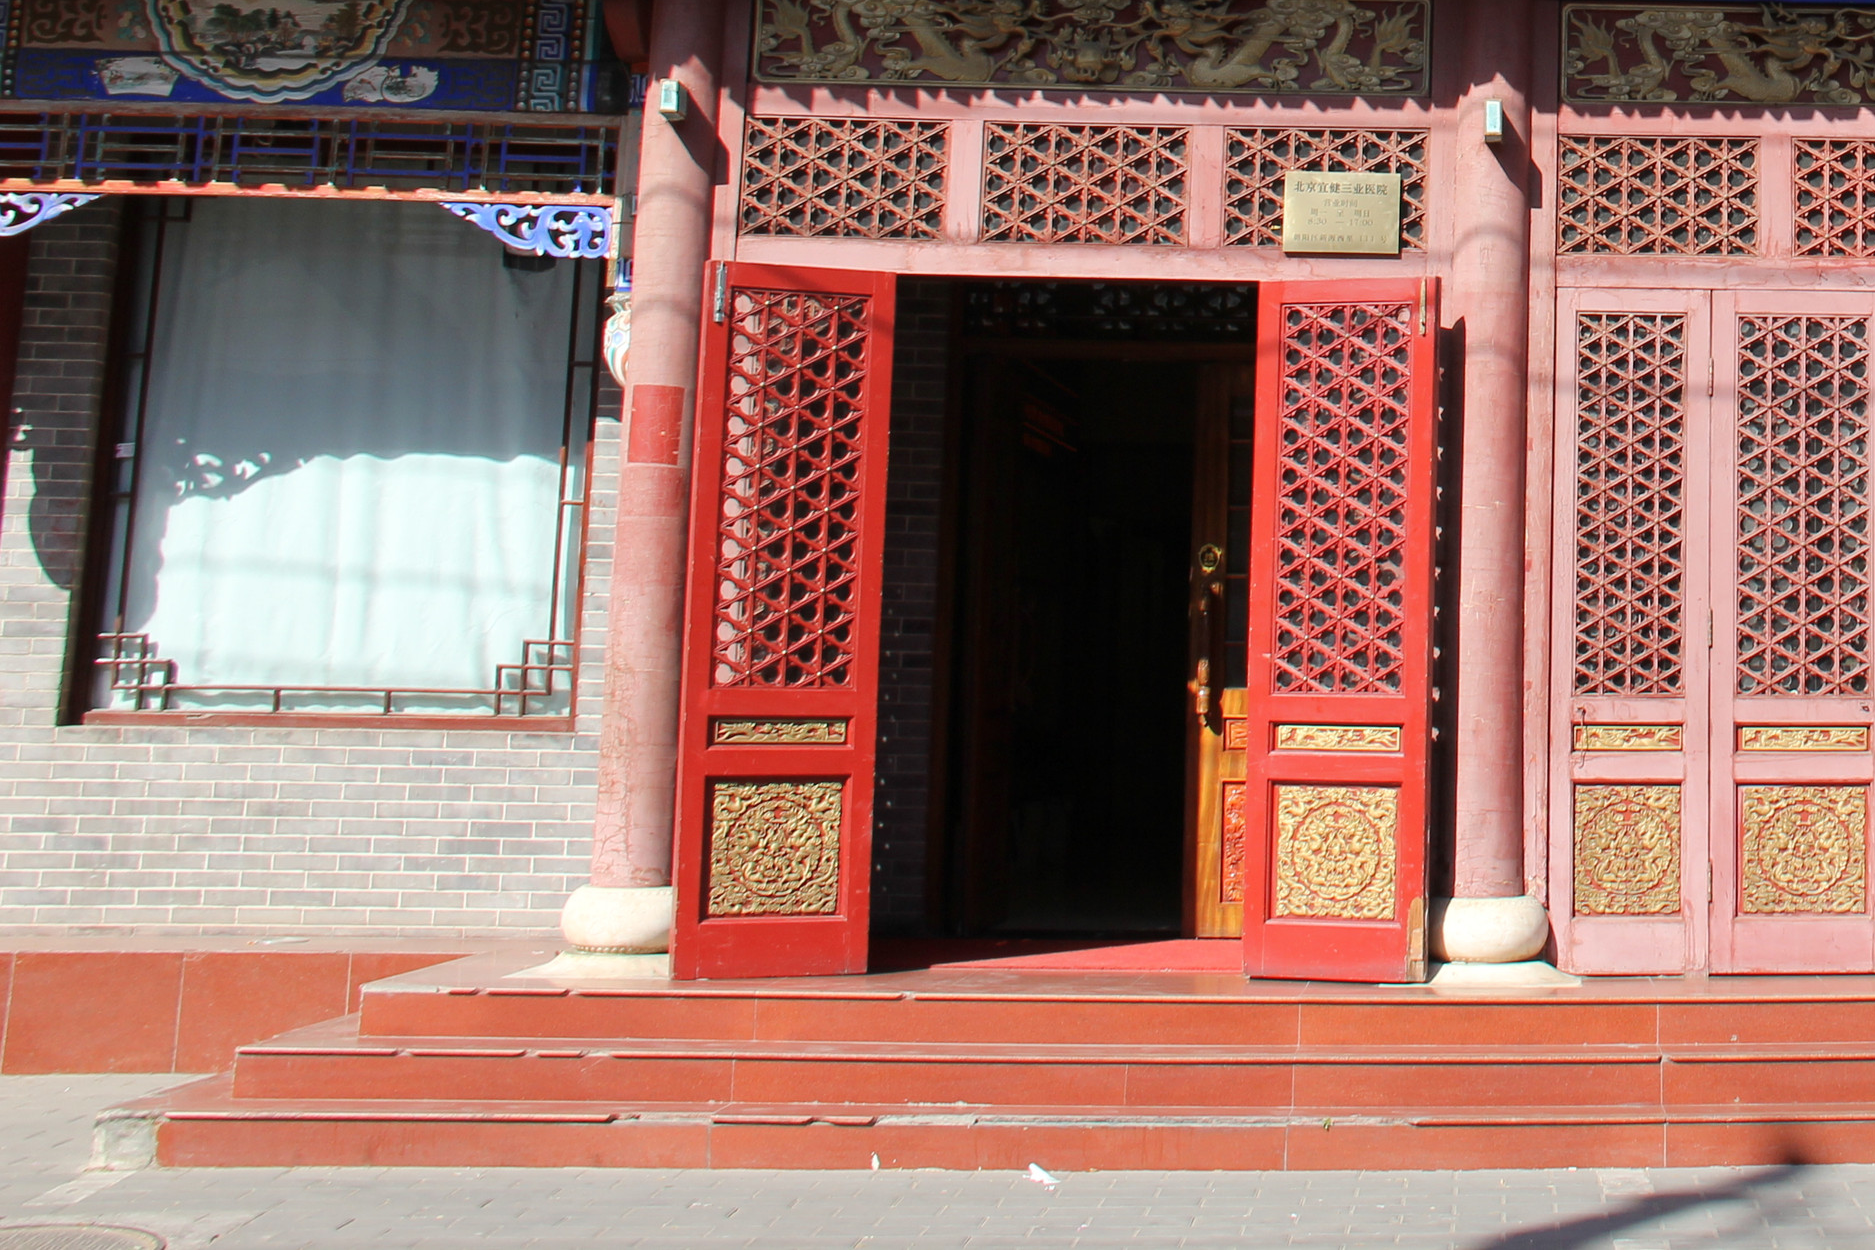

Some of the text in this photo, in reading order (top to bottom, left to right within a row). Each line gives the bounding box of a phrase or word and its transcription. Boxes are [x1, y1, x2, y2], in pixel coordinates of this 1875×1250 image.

[1294, 180, 1388, 196] 北京宜健三业医院
[1323, 198, 1358, 208] 营业时间
[1307, 217, 1327, 225] 8:30
[1349, 218, 1373, 226] 17:00
